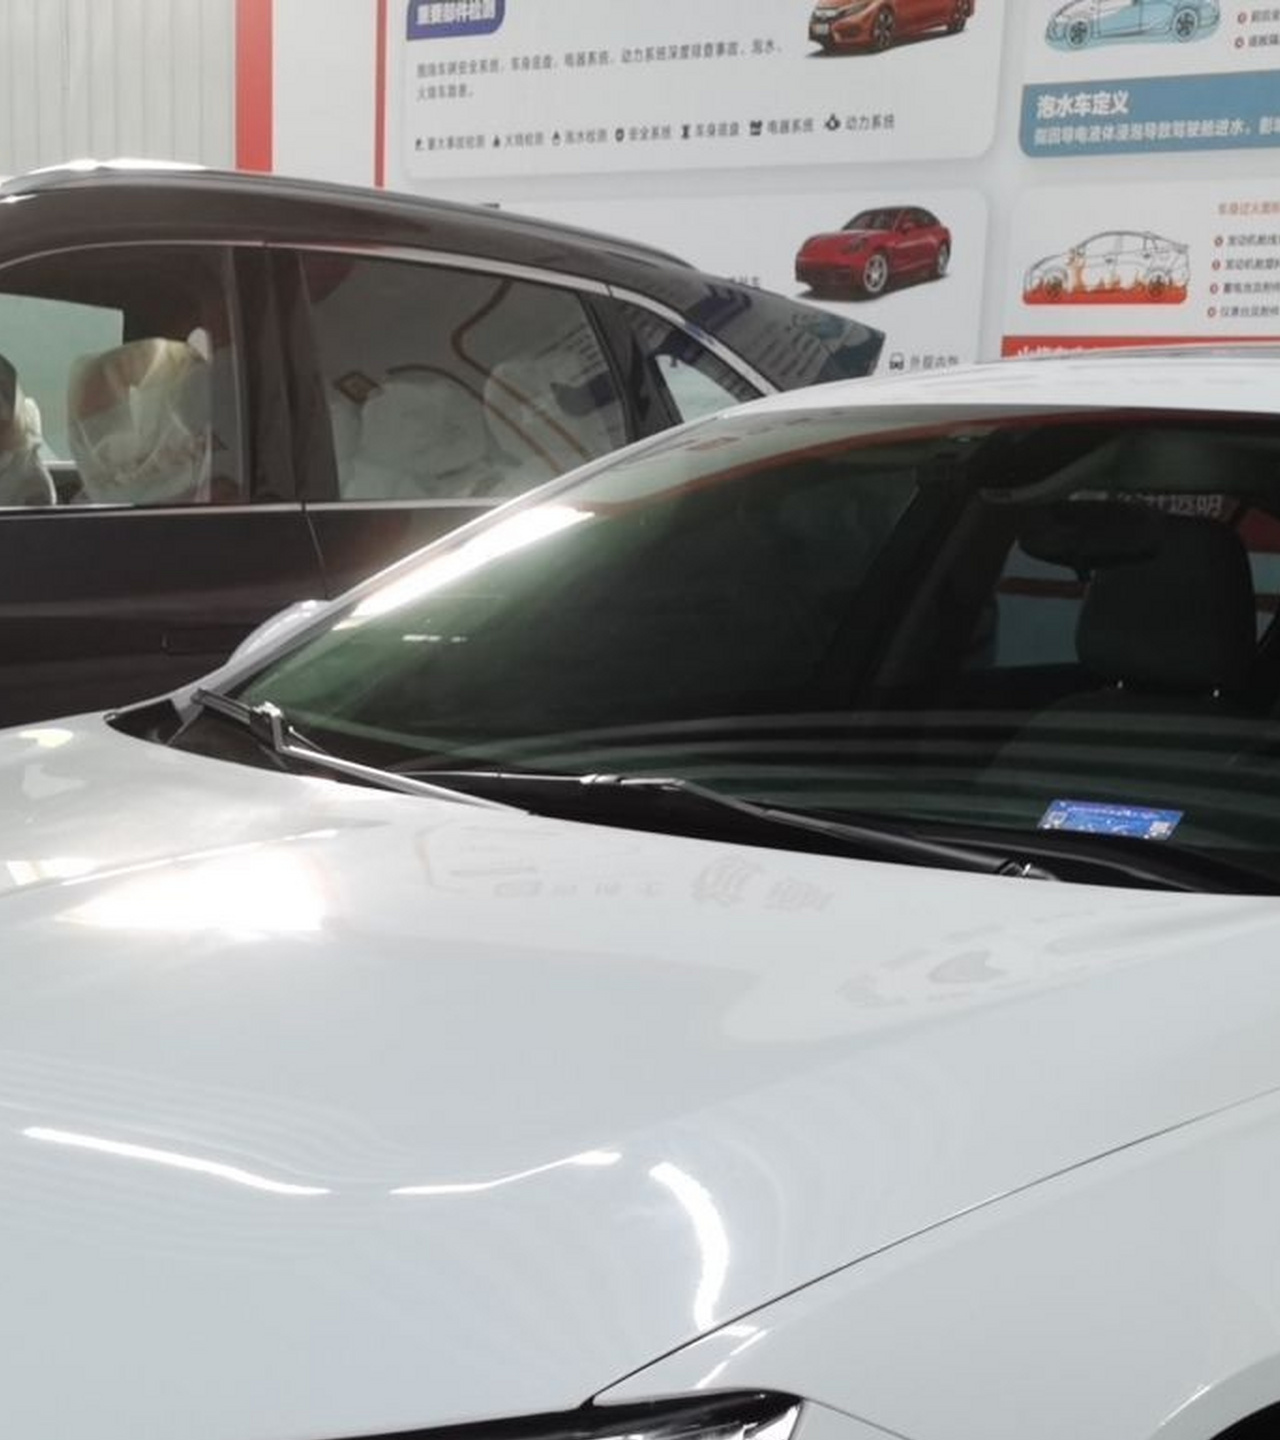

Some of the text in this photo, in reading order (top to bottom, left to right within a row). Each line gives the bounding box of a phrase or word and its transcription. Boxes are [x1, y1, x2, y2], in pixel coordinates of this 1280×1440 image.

[1036, 91, 1129, 119] 泡水车定义
[845, 114, 895, 131] 动力系统
